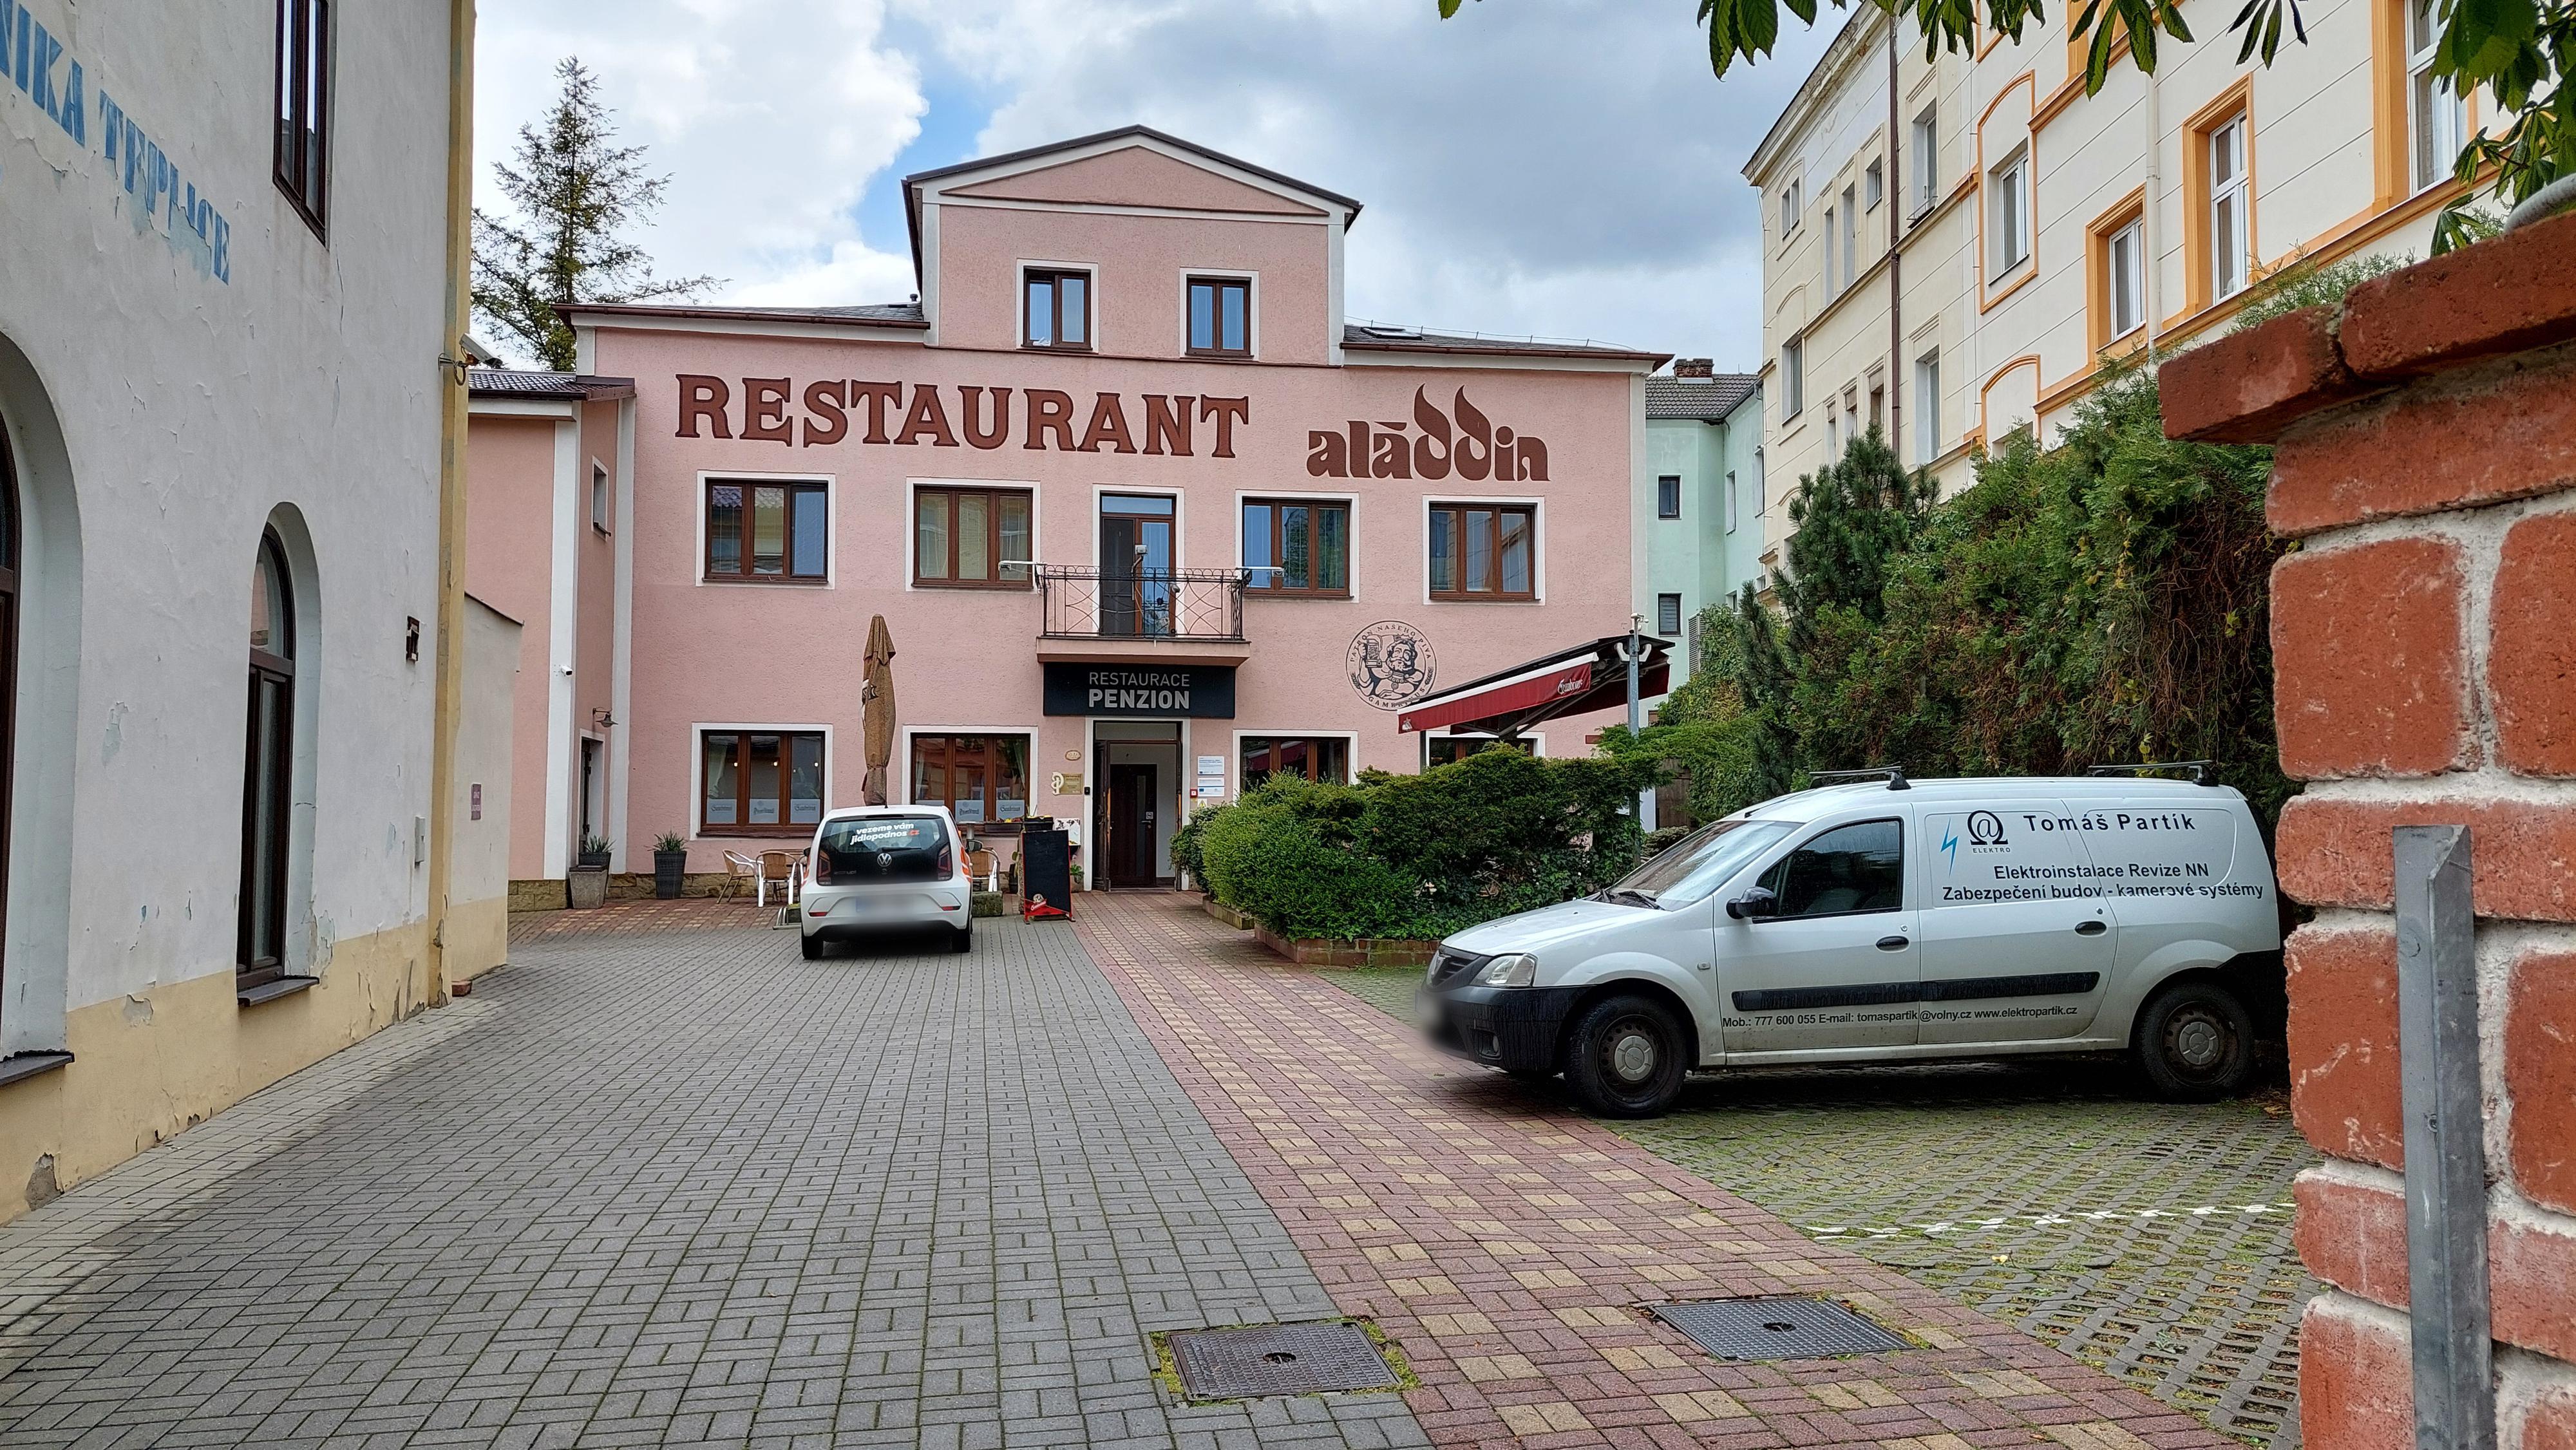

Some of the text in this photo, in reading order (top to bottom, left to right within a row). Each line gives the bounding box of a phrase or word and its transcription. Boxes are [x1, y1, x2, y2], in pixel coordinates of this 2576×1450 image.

[675, 373, 1249, 458] RESTAURANT
[1417, 638, 1432, 659] PIVA
[1089, 672, 1190, 687] RESTAURACE
[1088, 689, 1189, 709] PENZION
[856, 825, 891, 834] vezeme
[2023, 813, 2108, 831] Tomáš
[1994, 863, 2209, 879] Elektroinstalace Revize NN
[1942, 885, 2046, 903] Zabezpečení
[2051, 884, 2103, 898] budov
[2116, 882, 2195, 897] kamerové
[2200, 882, 2263, 899] systémy
[1722, 1017, 1751, 1027] Mob.:
[1754, 1016, 1773, 1026] 777
[1776, 1015, 1794, 1024] 600
[1797, 1014, 1816, 1024] 055
[1819, 1013, 1854, 1024] E-mail:
[1975, 1006, 2078, 1018] www.elektropartik.cz
